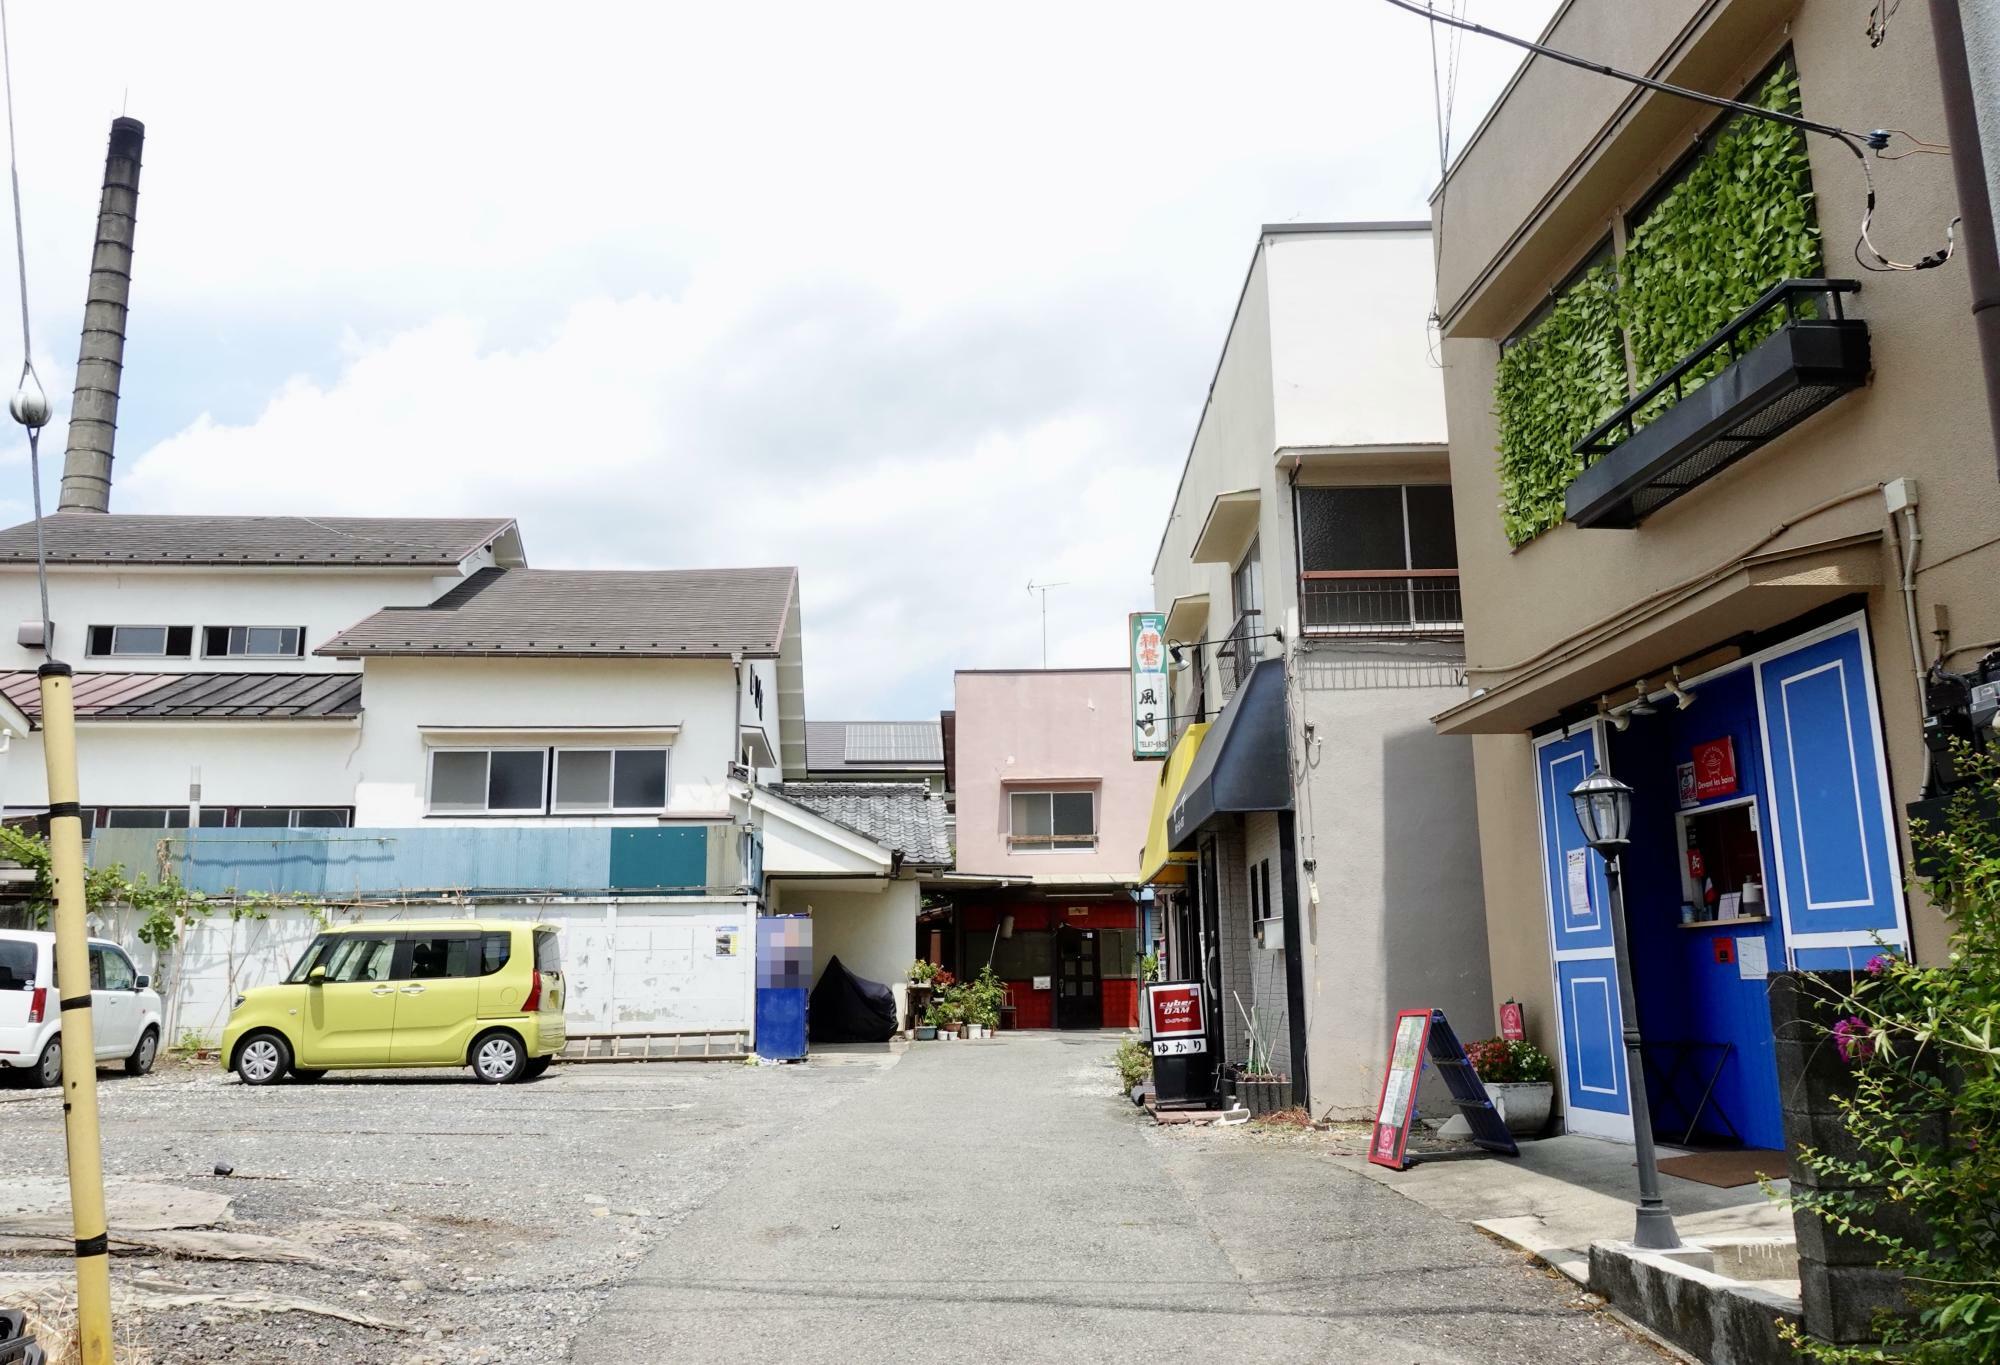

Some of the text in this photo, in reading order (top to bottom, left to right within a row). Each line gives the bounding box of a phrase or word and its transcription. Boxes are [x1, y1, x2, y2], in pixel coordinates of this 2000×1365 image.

[1164, 1006, 1190, 1015] DAM
[1157, 1040, 1202, 1054] ゆかり
